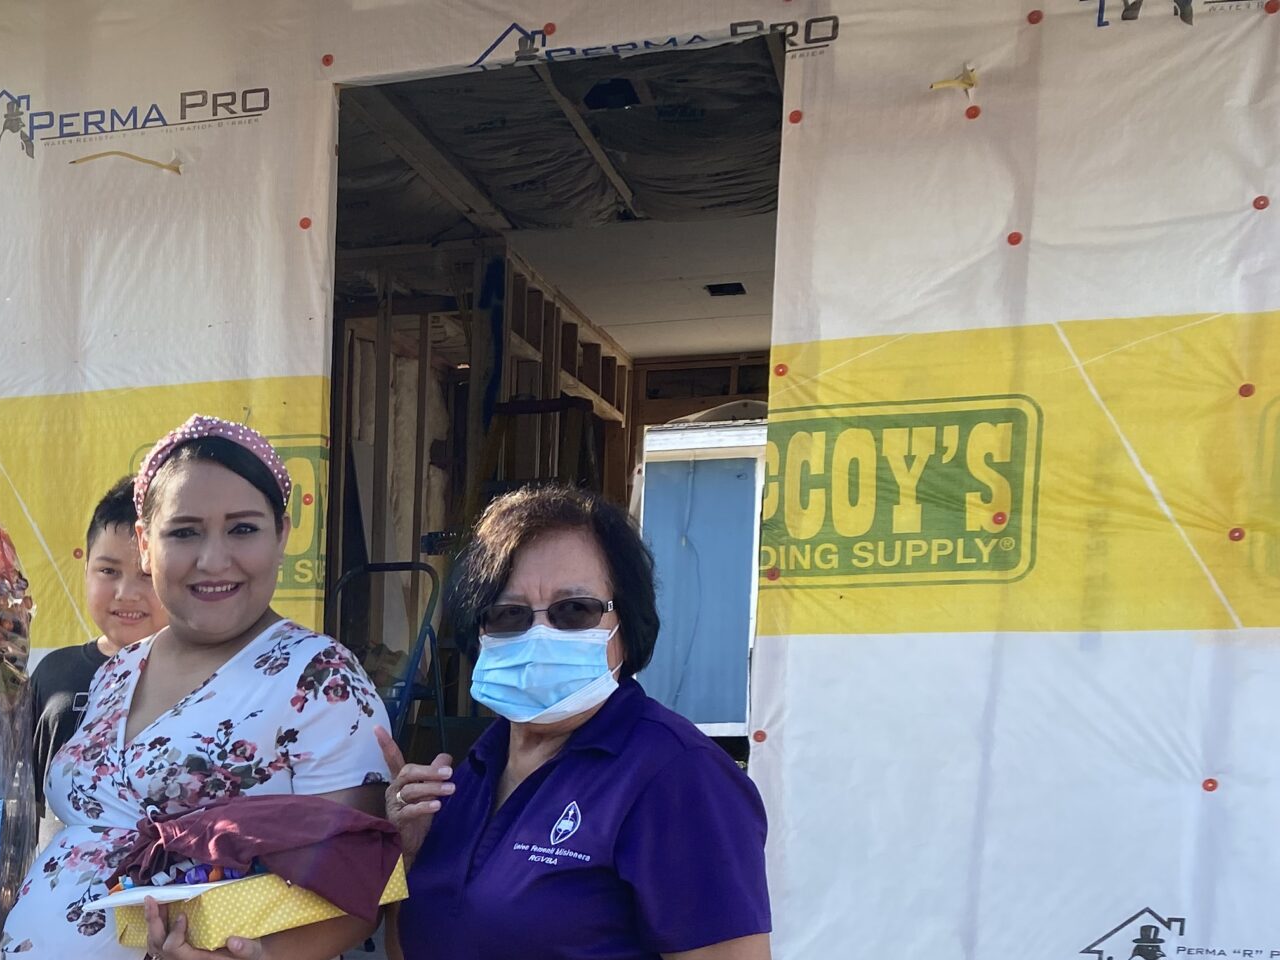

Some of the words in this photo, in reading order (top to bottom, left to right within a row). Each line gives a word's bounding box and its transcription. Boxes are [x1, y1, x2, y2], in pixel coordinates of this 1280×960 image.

[28, 104, 167, 141] PERMA
[180, 87, 270, 121] PRO
[1176, 946, 1228, 956] PERMA
